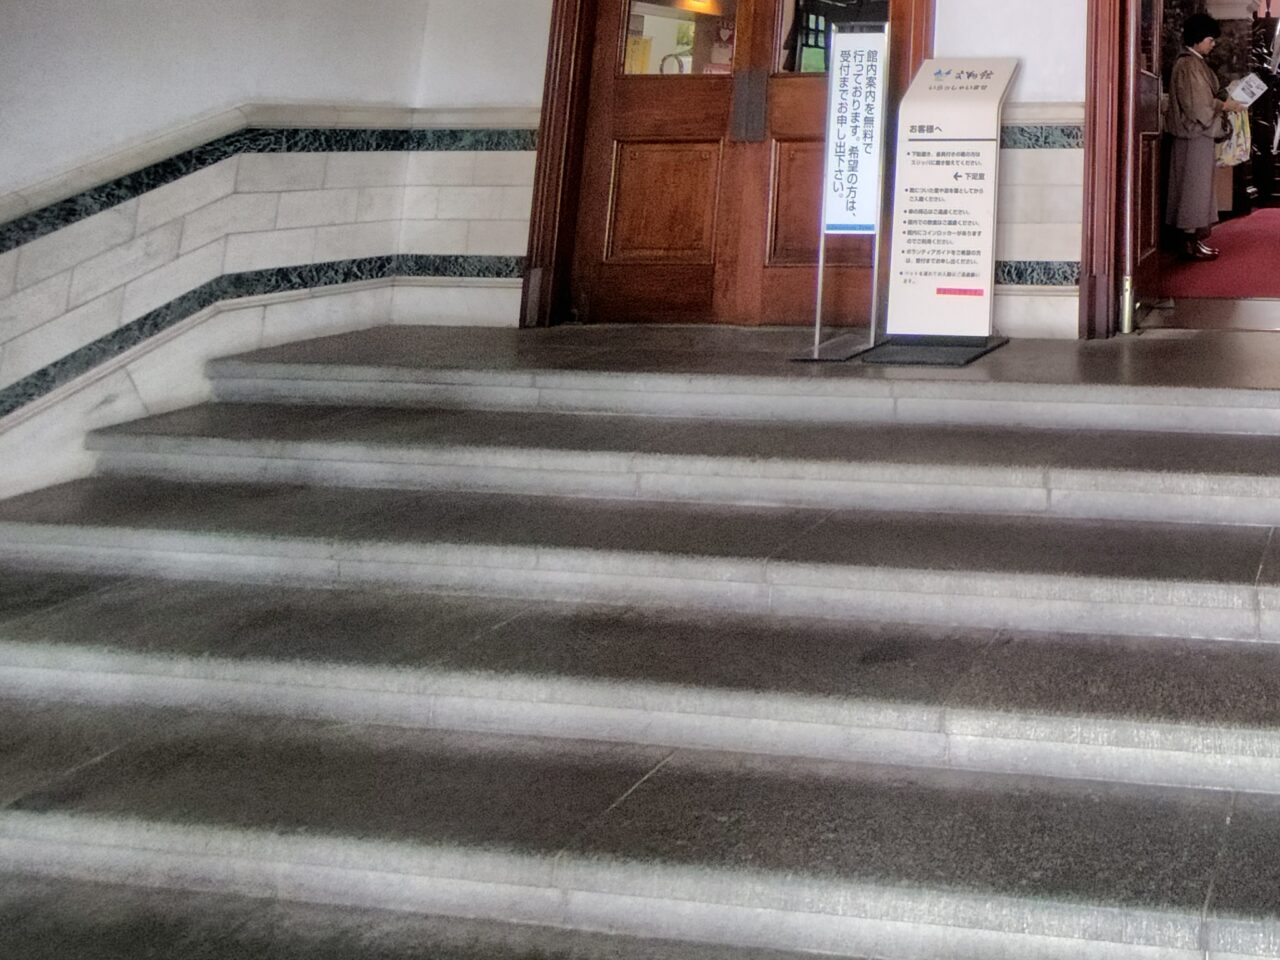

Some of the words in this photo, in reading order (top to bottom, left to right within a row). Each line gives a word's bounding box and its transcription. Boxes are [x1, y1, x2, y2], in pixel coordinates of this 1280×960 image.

[832, 49, 851, 199] 受付までお申し出下さい。
[862, 49, 878, 155] 館内案内を無料で
[909, 125, 943, 134] お客様へ
